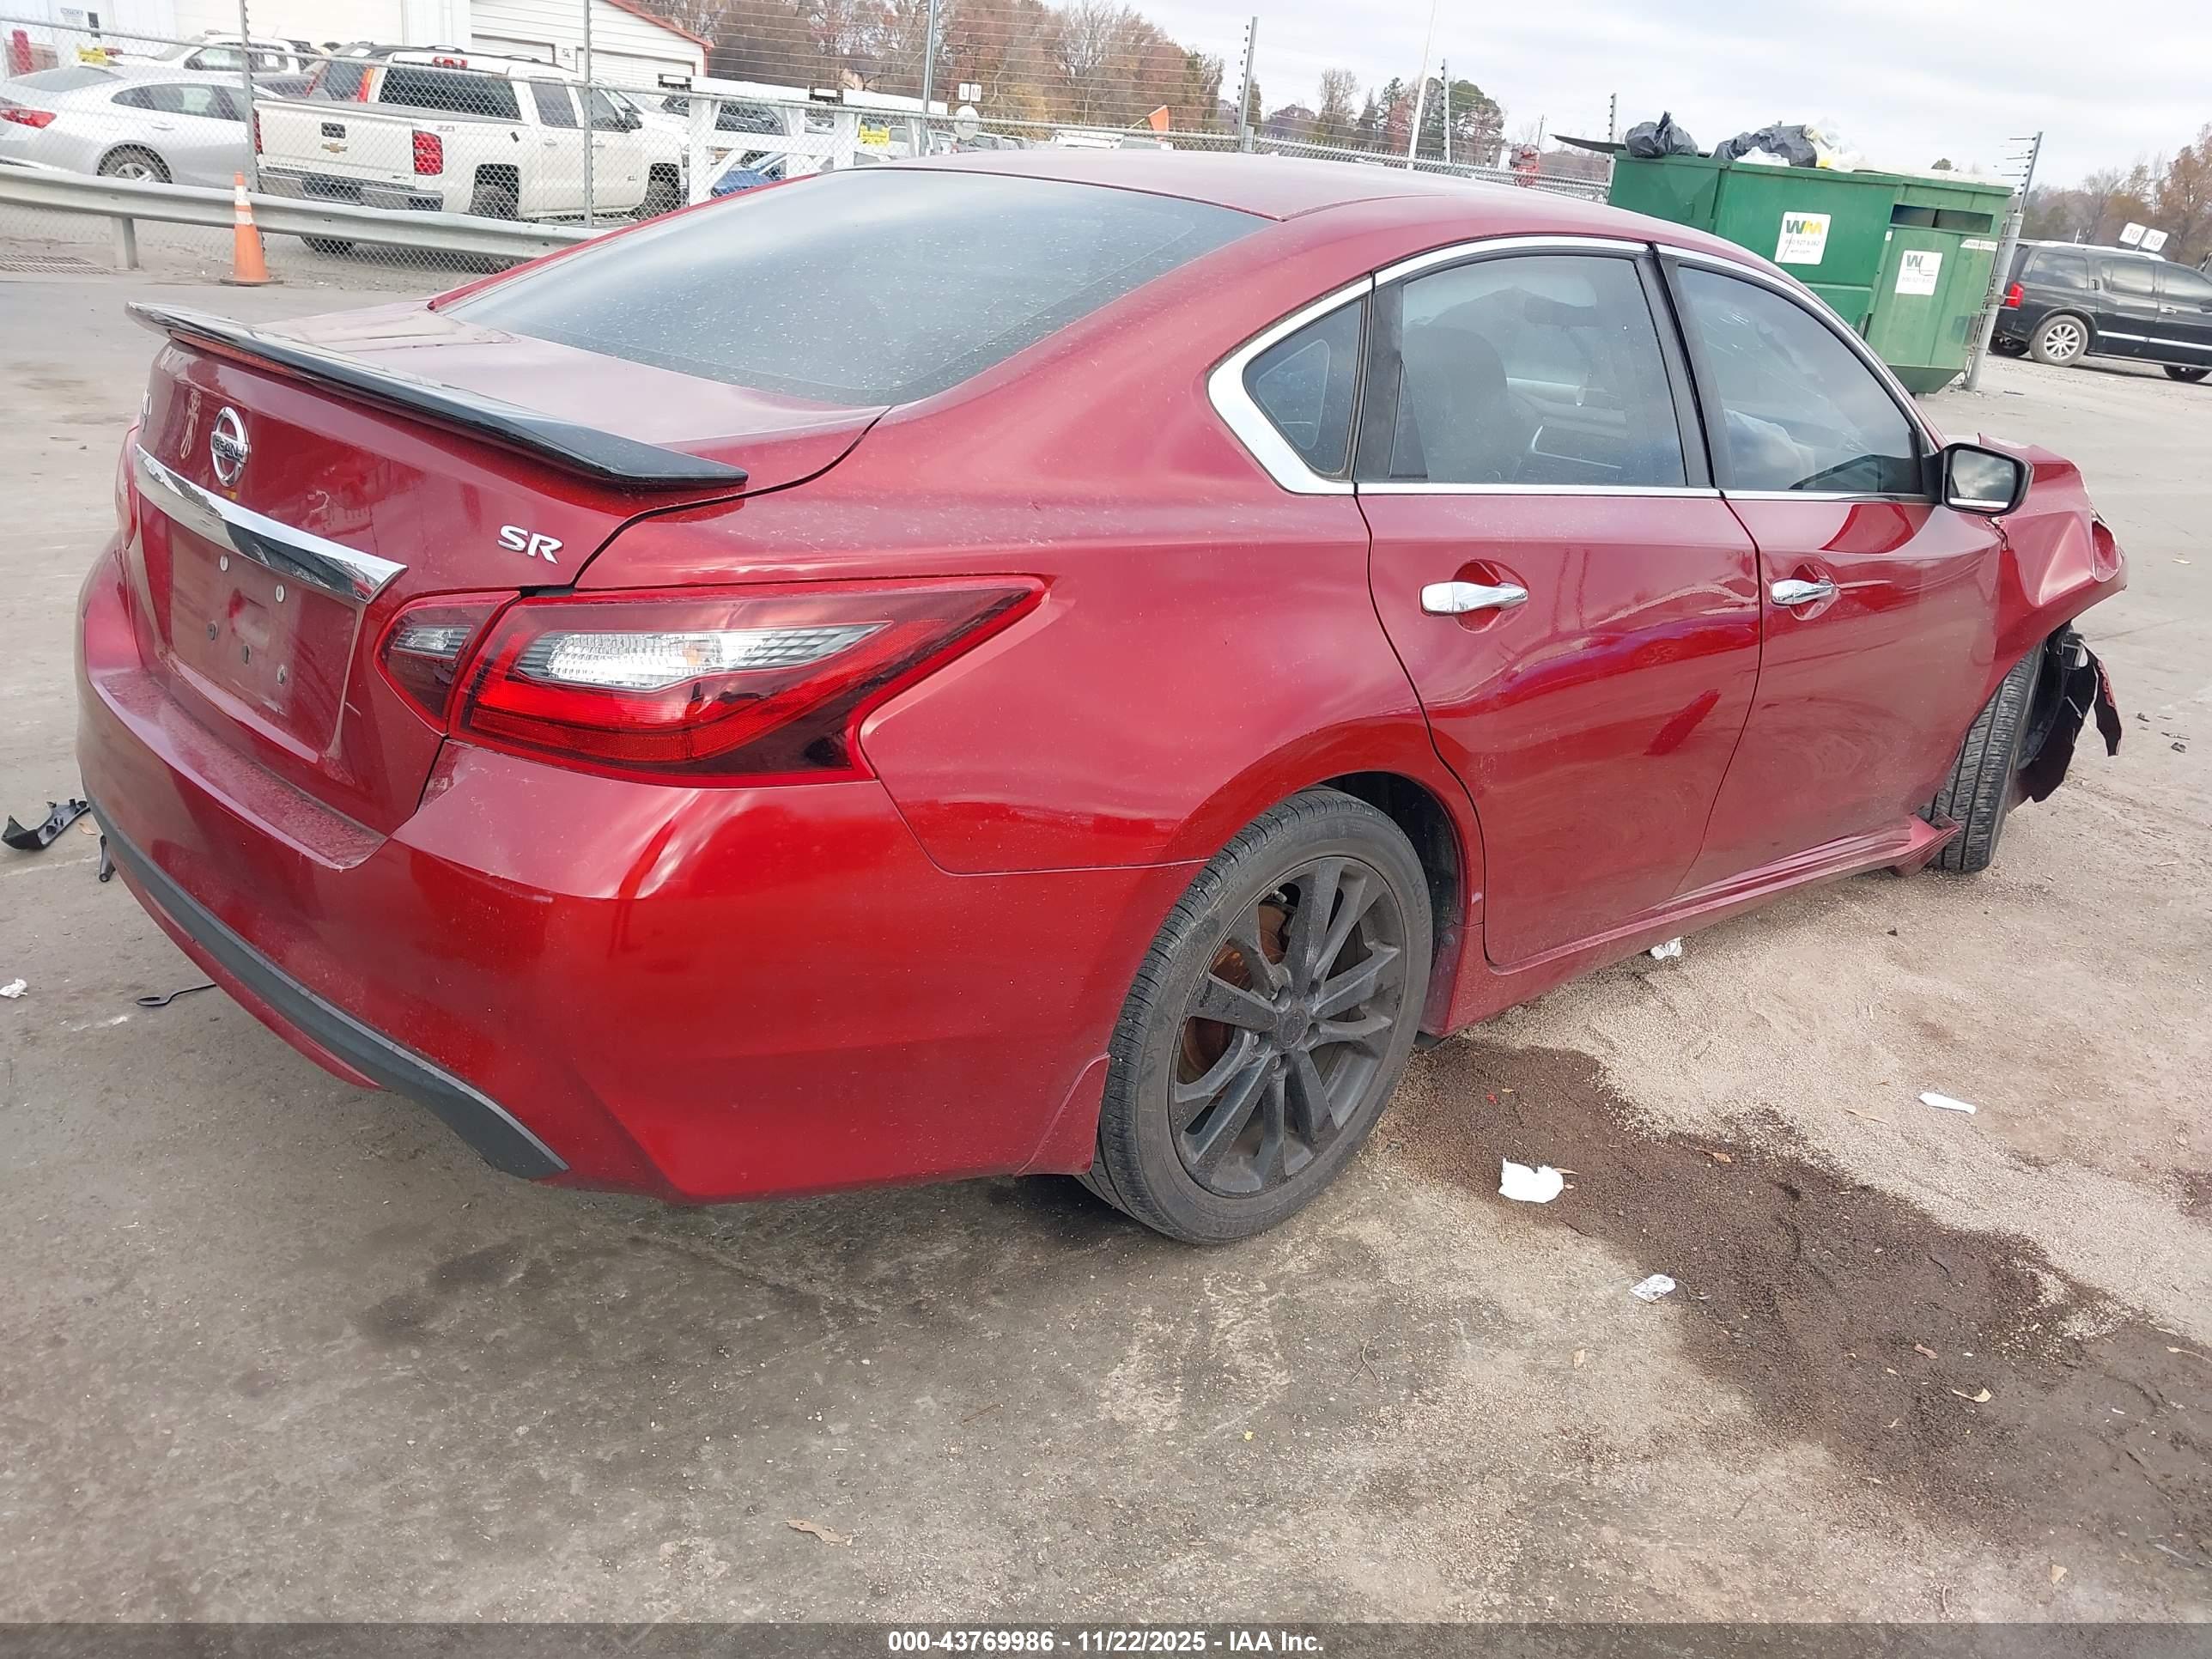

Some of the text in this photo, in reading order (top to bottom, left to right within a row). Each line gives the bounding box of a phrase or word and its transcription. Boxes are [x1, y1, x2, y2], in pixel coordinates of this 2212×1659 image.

[1786, 220, 1822, 234] WM
[2127, 228, 2140, 240] 10
[2148, 234, 2162, 246] 10
[497, 525, 563, 564] SR
